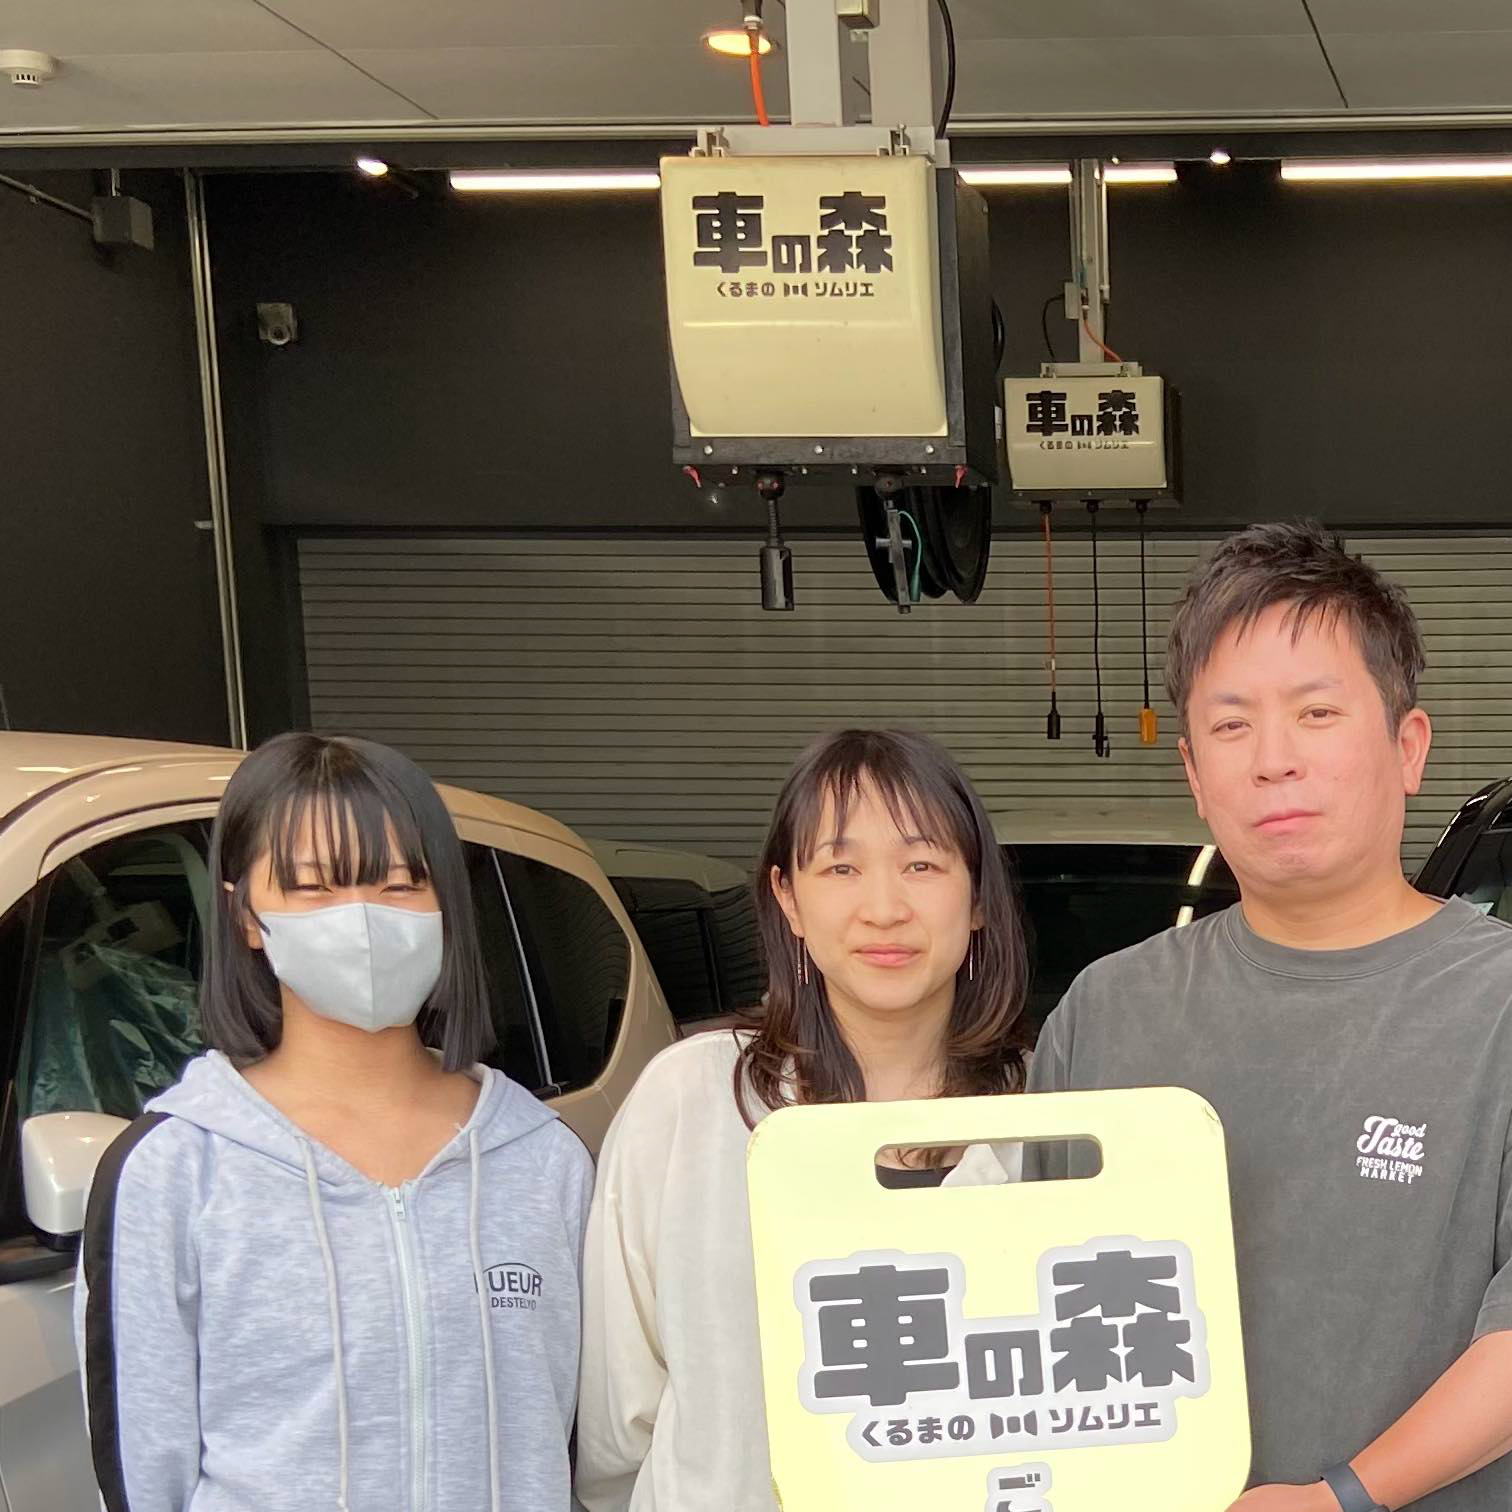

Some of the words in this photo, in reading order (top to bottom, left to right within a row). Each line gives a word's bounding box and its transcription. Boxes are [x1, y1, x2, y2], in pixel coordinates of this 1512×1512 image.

[692, 191, 893, 273] 車の森
[717, 281, 775, 297] くるまの
[815, 281, 875, 297] ソムリエ
[1025, 390, 1139, 436] 車の森
[1357, 1116, 1425, 1160] Taste
[1391, 1123, 1427, 1138] good
[1356, 1157, 1387, 1170] FRESH
[1390, 1161, 1423, 1176] LEMON
[1360, 1167, 1415, 1184] MARKET
[809, 1251, 1196, 1407] 車の森
[861, 1415, 975, 1447] くるまの
[1049, 1402, 1162, 1434] ソムリエ
